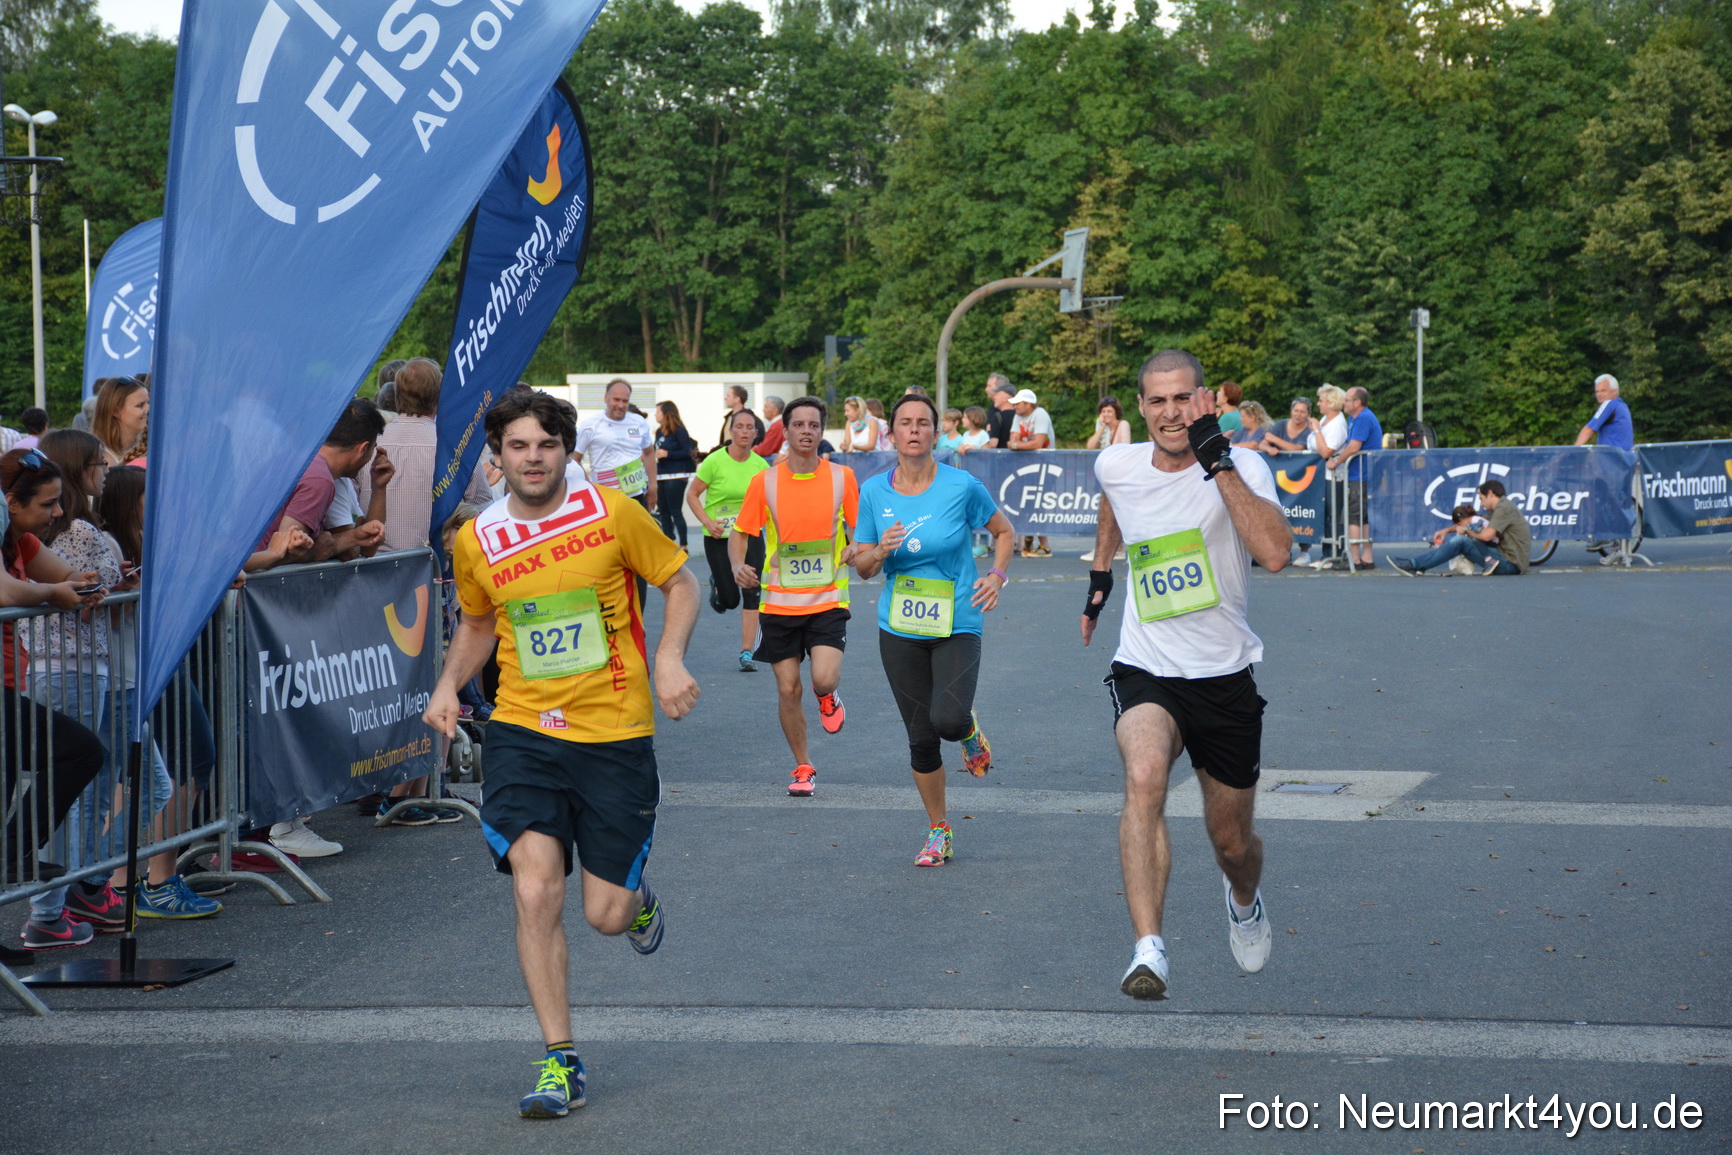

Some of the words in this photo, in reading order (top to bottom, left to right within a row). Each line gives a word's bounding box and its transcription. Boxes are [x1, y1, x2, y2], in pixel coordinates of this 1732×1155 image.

[516, 270, 541, 316] Druck
[556, 194, 585, 255] Medien
[454, 215, 551, 387] Frischmann
[1643, 471, 1727, 498] Frischmann
[1454, 486, 1590, 511] Ficher
[1694, 497, 1713, 510] Druck
[1714, 496, 1728, 508] und
[917, 514, 932, 523] Bau
[1282, 505, 1316, 519] edien
[1528, 514, 1578, 526] OBILE
[492, 553, 547, 589] MAX
[550, 527, 615, 562] BÖGL
[790, 558, 823, 575] 304
[1140, 562, 1203, 599] 1669
[902, 599, 940, 621] 804
[530, 623, 583, 657] 827
[542, 660, 559, 668] Marco
[259, 640, 397, 715] Frischmann
[348, 701, 380, 734] Druck
[381, 694, 401, 726] und
